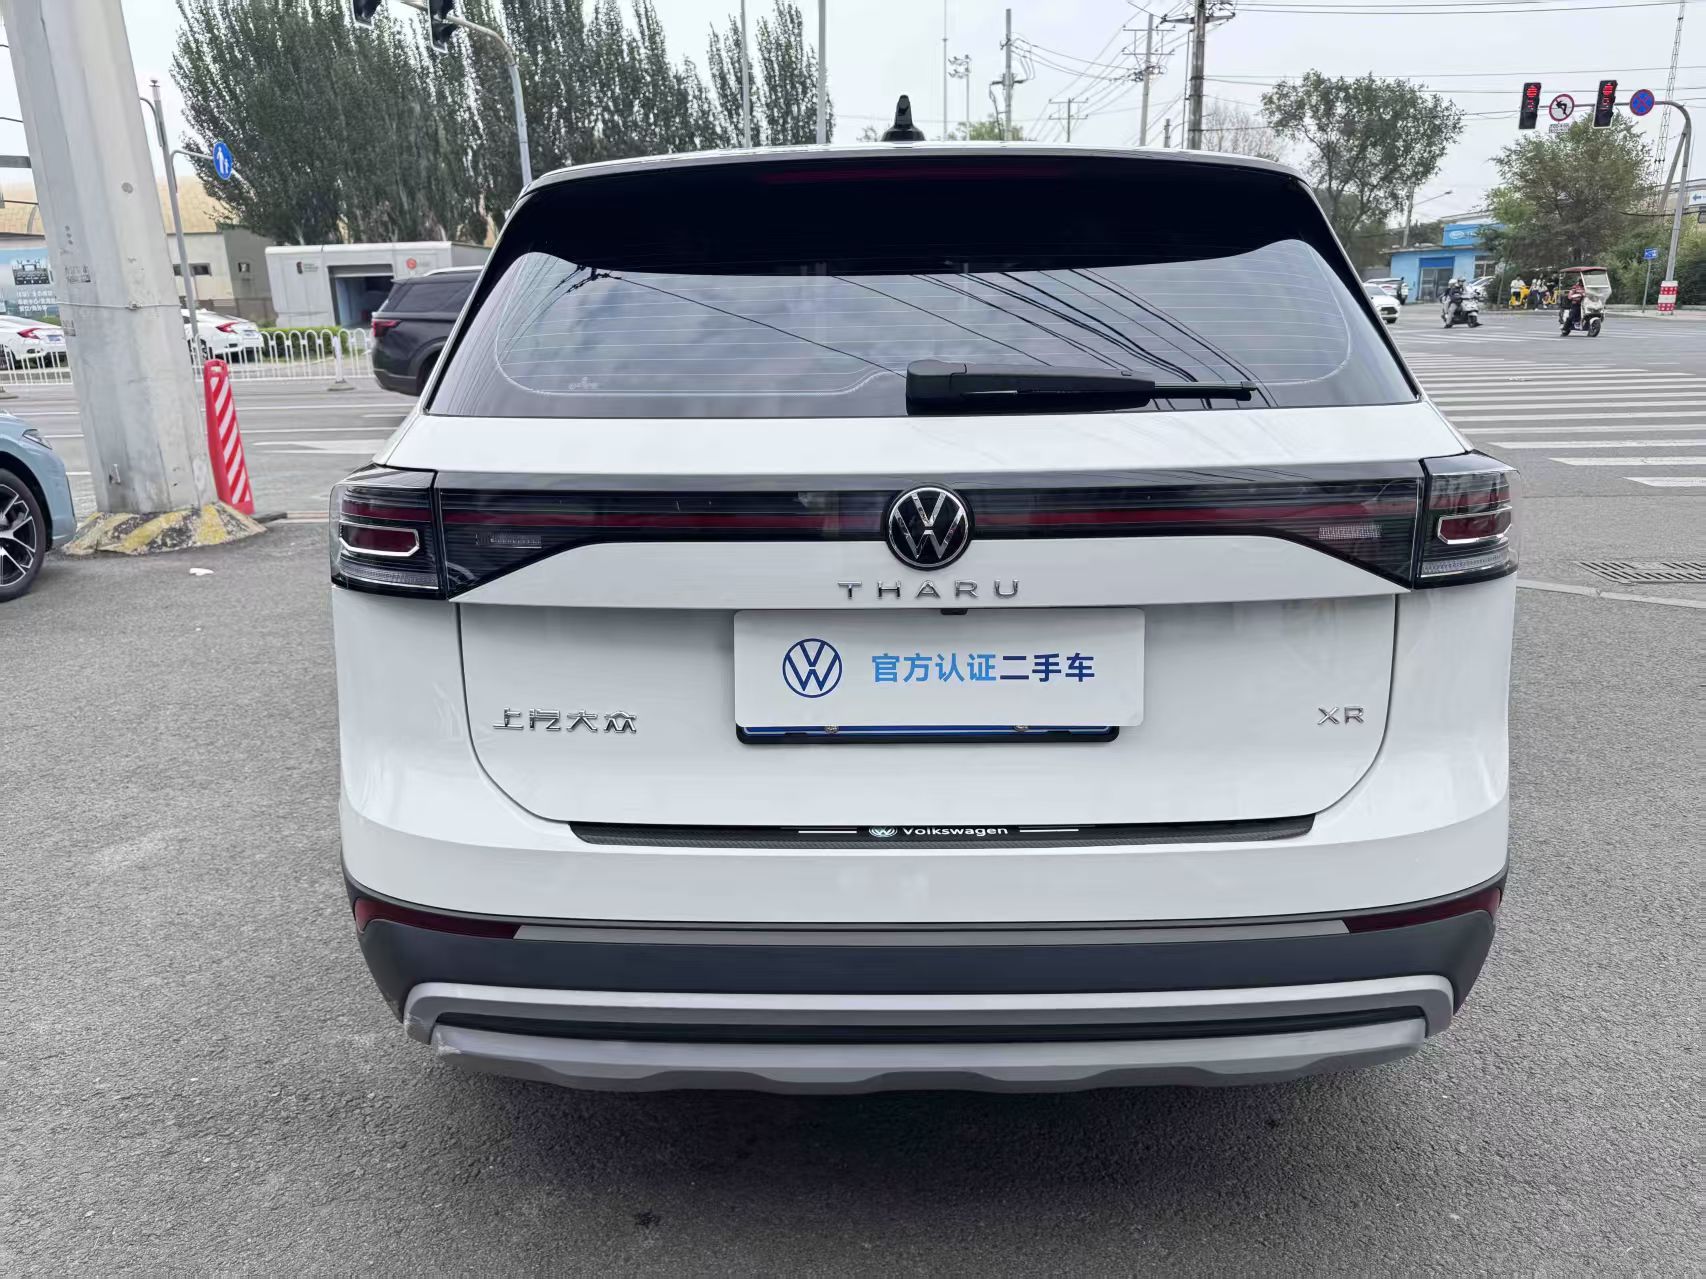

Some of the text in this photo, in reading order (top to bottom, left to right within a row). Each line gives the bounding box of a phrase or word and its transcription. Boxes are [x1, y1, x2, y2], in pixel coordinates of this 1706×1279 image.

[838, 579, 1019, 598] THARU
[871, 652, 1096, 683] 官方认证二手车
[493, 707, 637, 733] 上汽大众
[1317, 706, 1365, 725] XR
[902, 826, 1008, 837] Volkswagen
